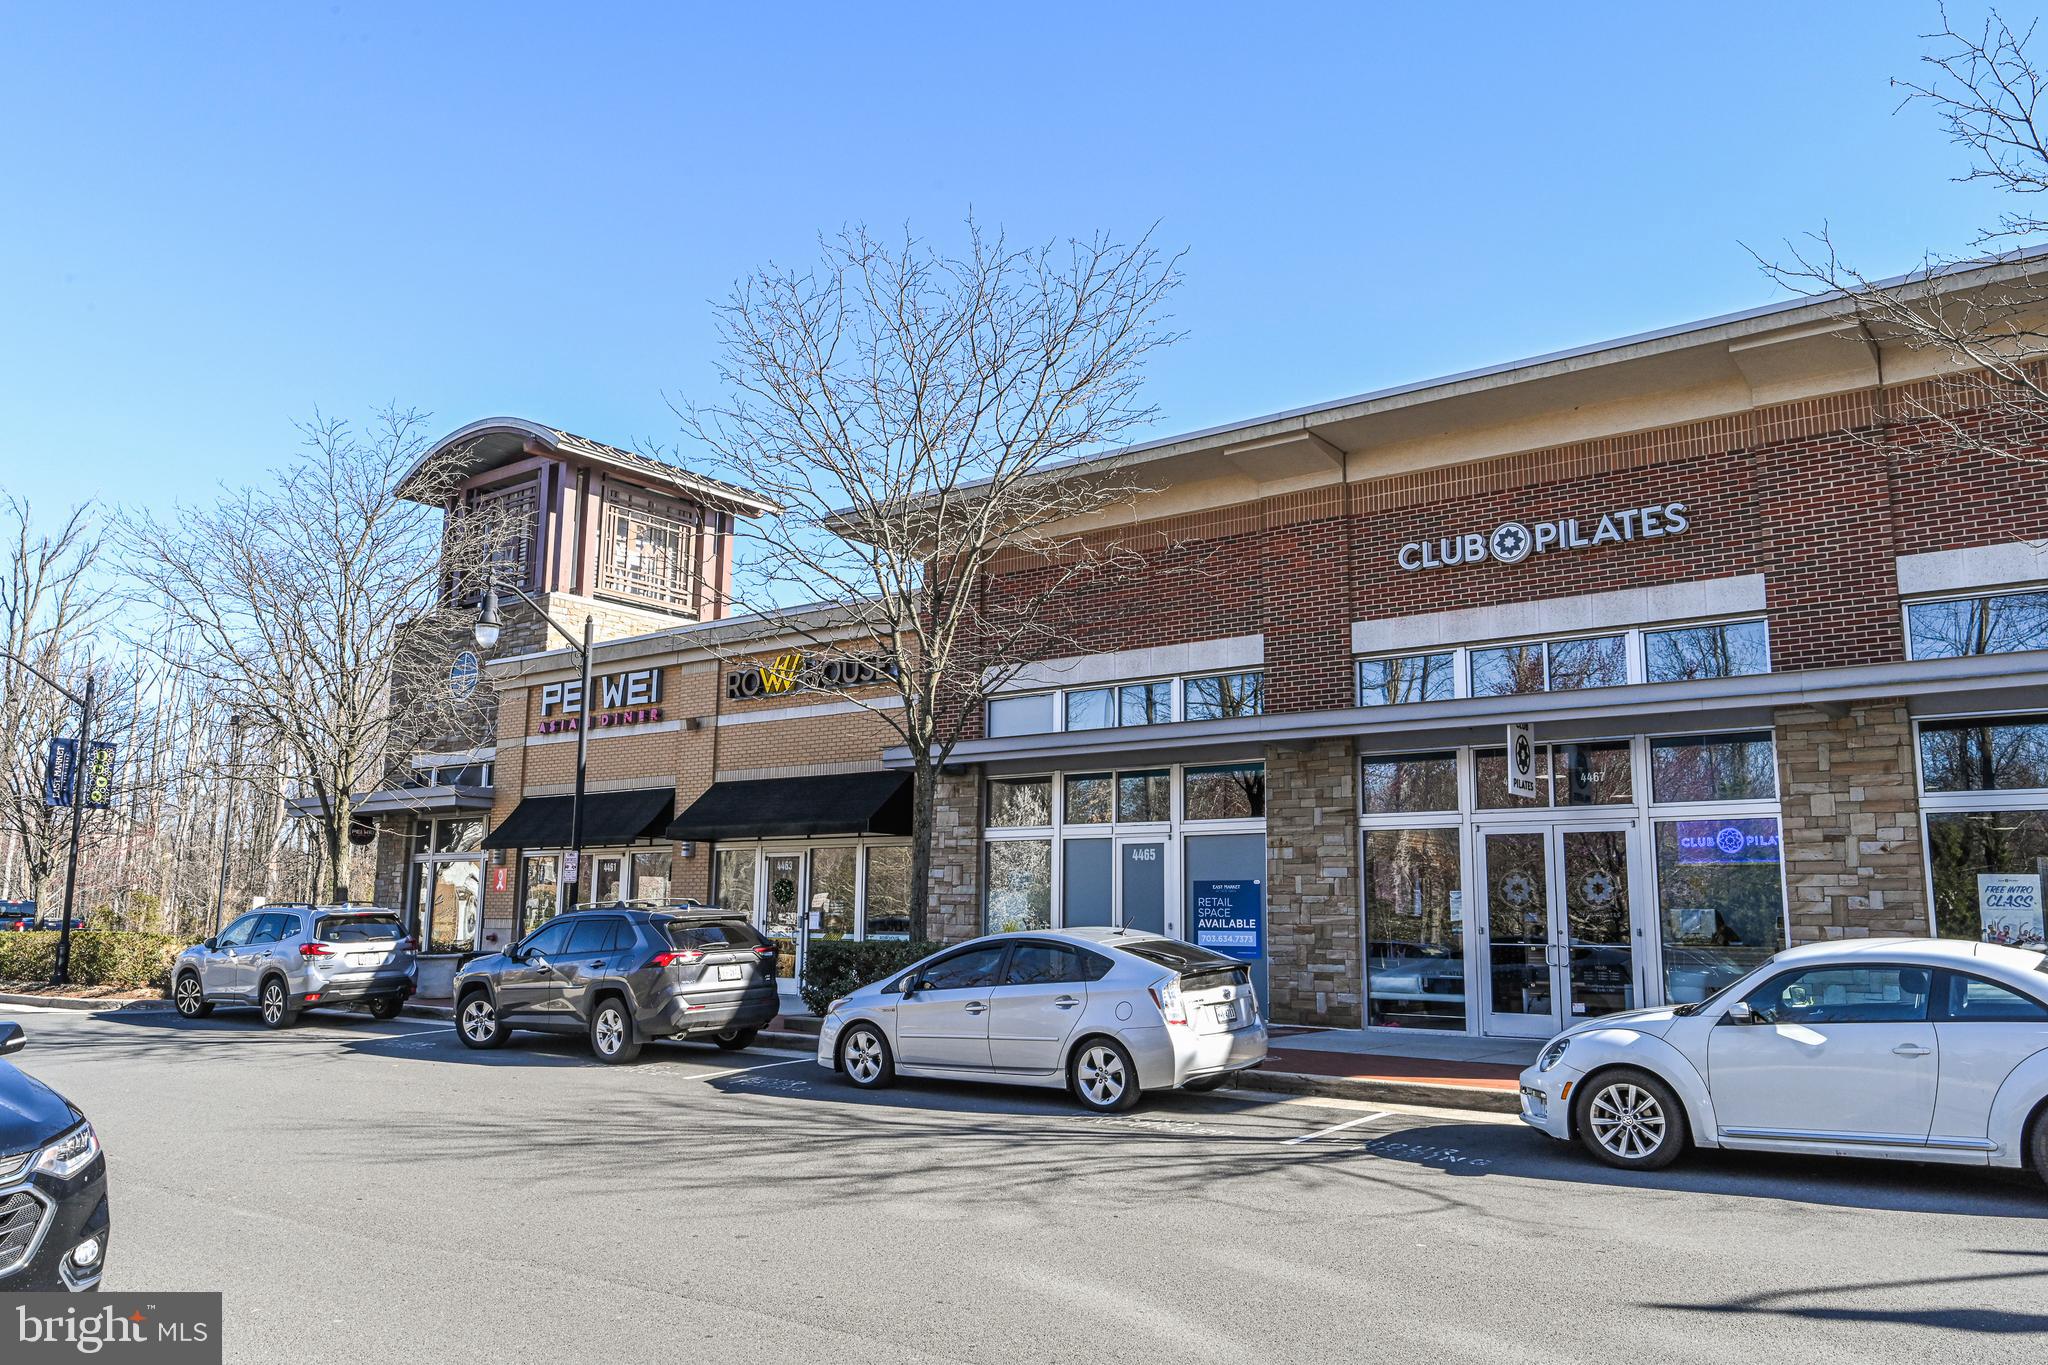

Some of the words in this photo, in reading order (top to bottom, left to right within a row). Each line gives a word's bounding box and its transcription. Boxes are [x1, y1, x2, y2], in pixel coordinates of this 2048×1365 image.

[1398, 533, 1488, 572] CLUB
[1535, 502, 1690, 553] PILATES
[541, 680, 595, 717] PE
[601, 669, 661, 709] WEI
[601, 708, 661, 727] DINER
[53, 746, 65, 777] MARKET
[1580, 771, 1604, 783] 4467
[52, 777, 62, 799] EAST
[1513, 778, 1534, 792] PILATES
[1681, 836, 1715, 848] CLUB
[1132, 848, 1156, 861] 4465
[776, 861, 793, 871] 4463
[1984, 885, 2006, 894] FREE
[2006, 885, 2034, 894] INTRO
[1198, 897, 1232, 907] RETAIL
[1986, 894, 2034, 908] CLASS
[1198, 908, 1231, 918] SPACE
[1198, 918, 1257, 929] AVAILABLE
[1201, 935, 1254, 943] 703.634.7373
